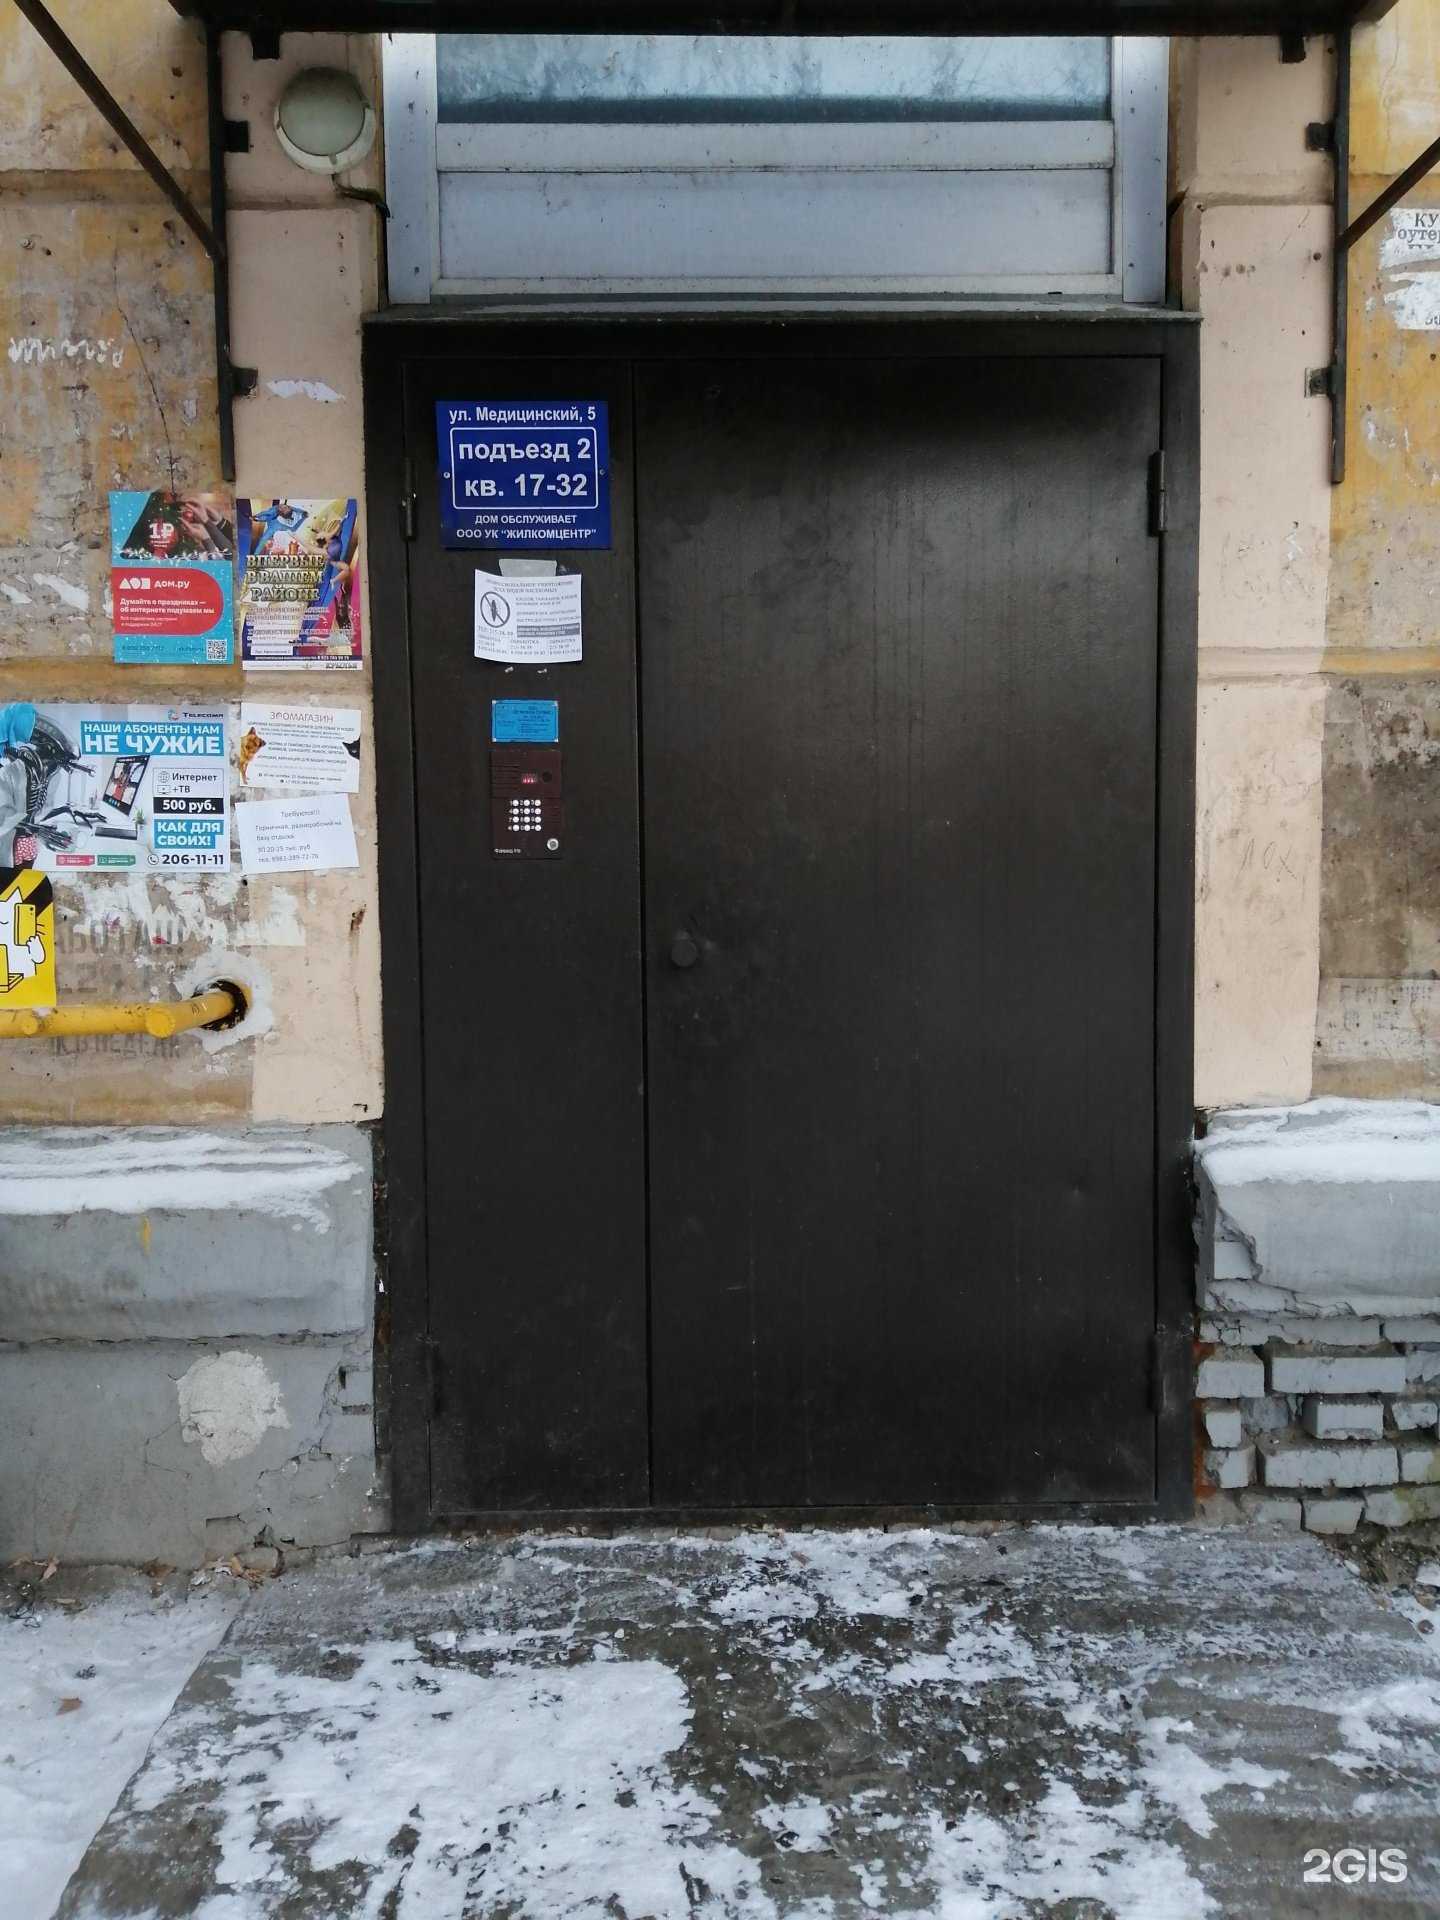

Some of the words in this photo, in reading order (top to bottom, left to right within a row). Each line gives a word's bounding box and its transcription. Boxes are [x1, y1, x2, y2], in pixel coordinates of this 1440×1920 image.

[449, 408, 473, 425] ул.
[476, 405, 584, 423] Медицинский,
[587, 406, 596, 421] 5
[458, 442, 570, 462] подъезд
[577, 438, 592, 460] 2
[465, 479, 505, 497] кв.
[514, 473, 589, 498] 17-32
[475, 515, 499, 525] ДОМ
[501, 514, 578, 525] ОБСЛУЖИВАЕТ
[456, 529, 482, 539] ООО
[484, 529, 499, 539] УК
[246, 555, 325, 569] ВПЕРВЫЕ
[251, 585, 320, 602] РАЙОНЕ
[120, 598, 151, 606] Думайте
[270, 711, 334, 724] ЗООМАГАЗИН
[84, 723, 121, 733] НАШИ
[124, 725, 190, 735] АБОНЕНТЫ
[193, 725, 220, 735] НАМ
[85, 735, 120, 753] НЕ
[125, 736, 221, 754] ЧУЖИЕ
[172, 772, 218, 784] Интернет
[173, 785, 191, 794] +ТВ
[162, 799, 186, 811] 500
[188, 799, 216, 813] руб.
[157, 822, 187, 833] КАК
[190, 822, 221, 835] ДЛЯ
[156, 834, 211, 846] СВОИХ!
[162, 854, 224, 865] 206-11-11
